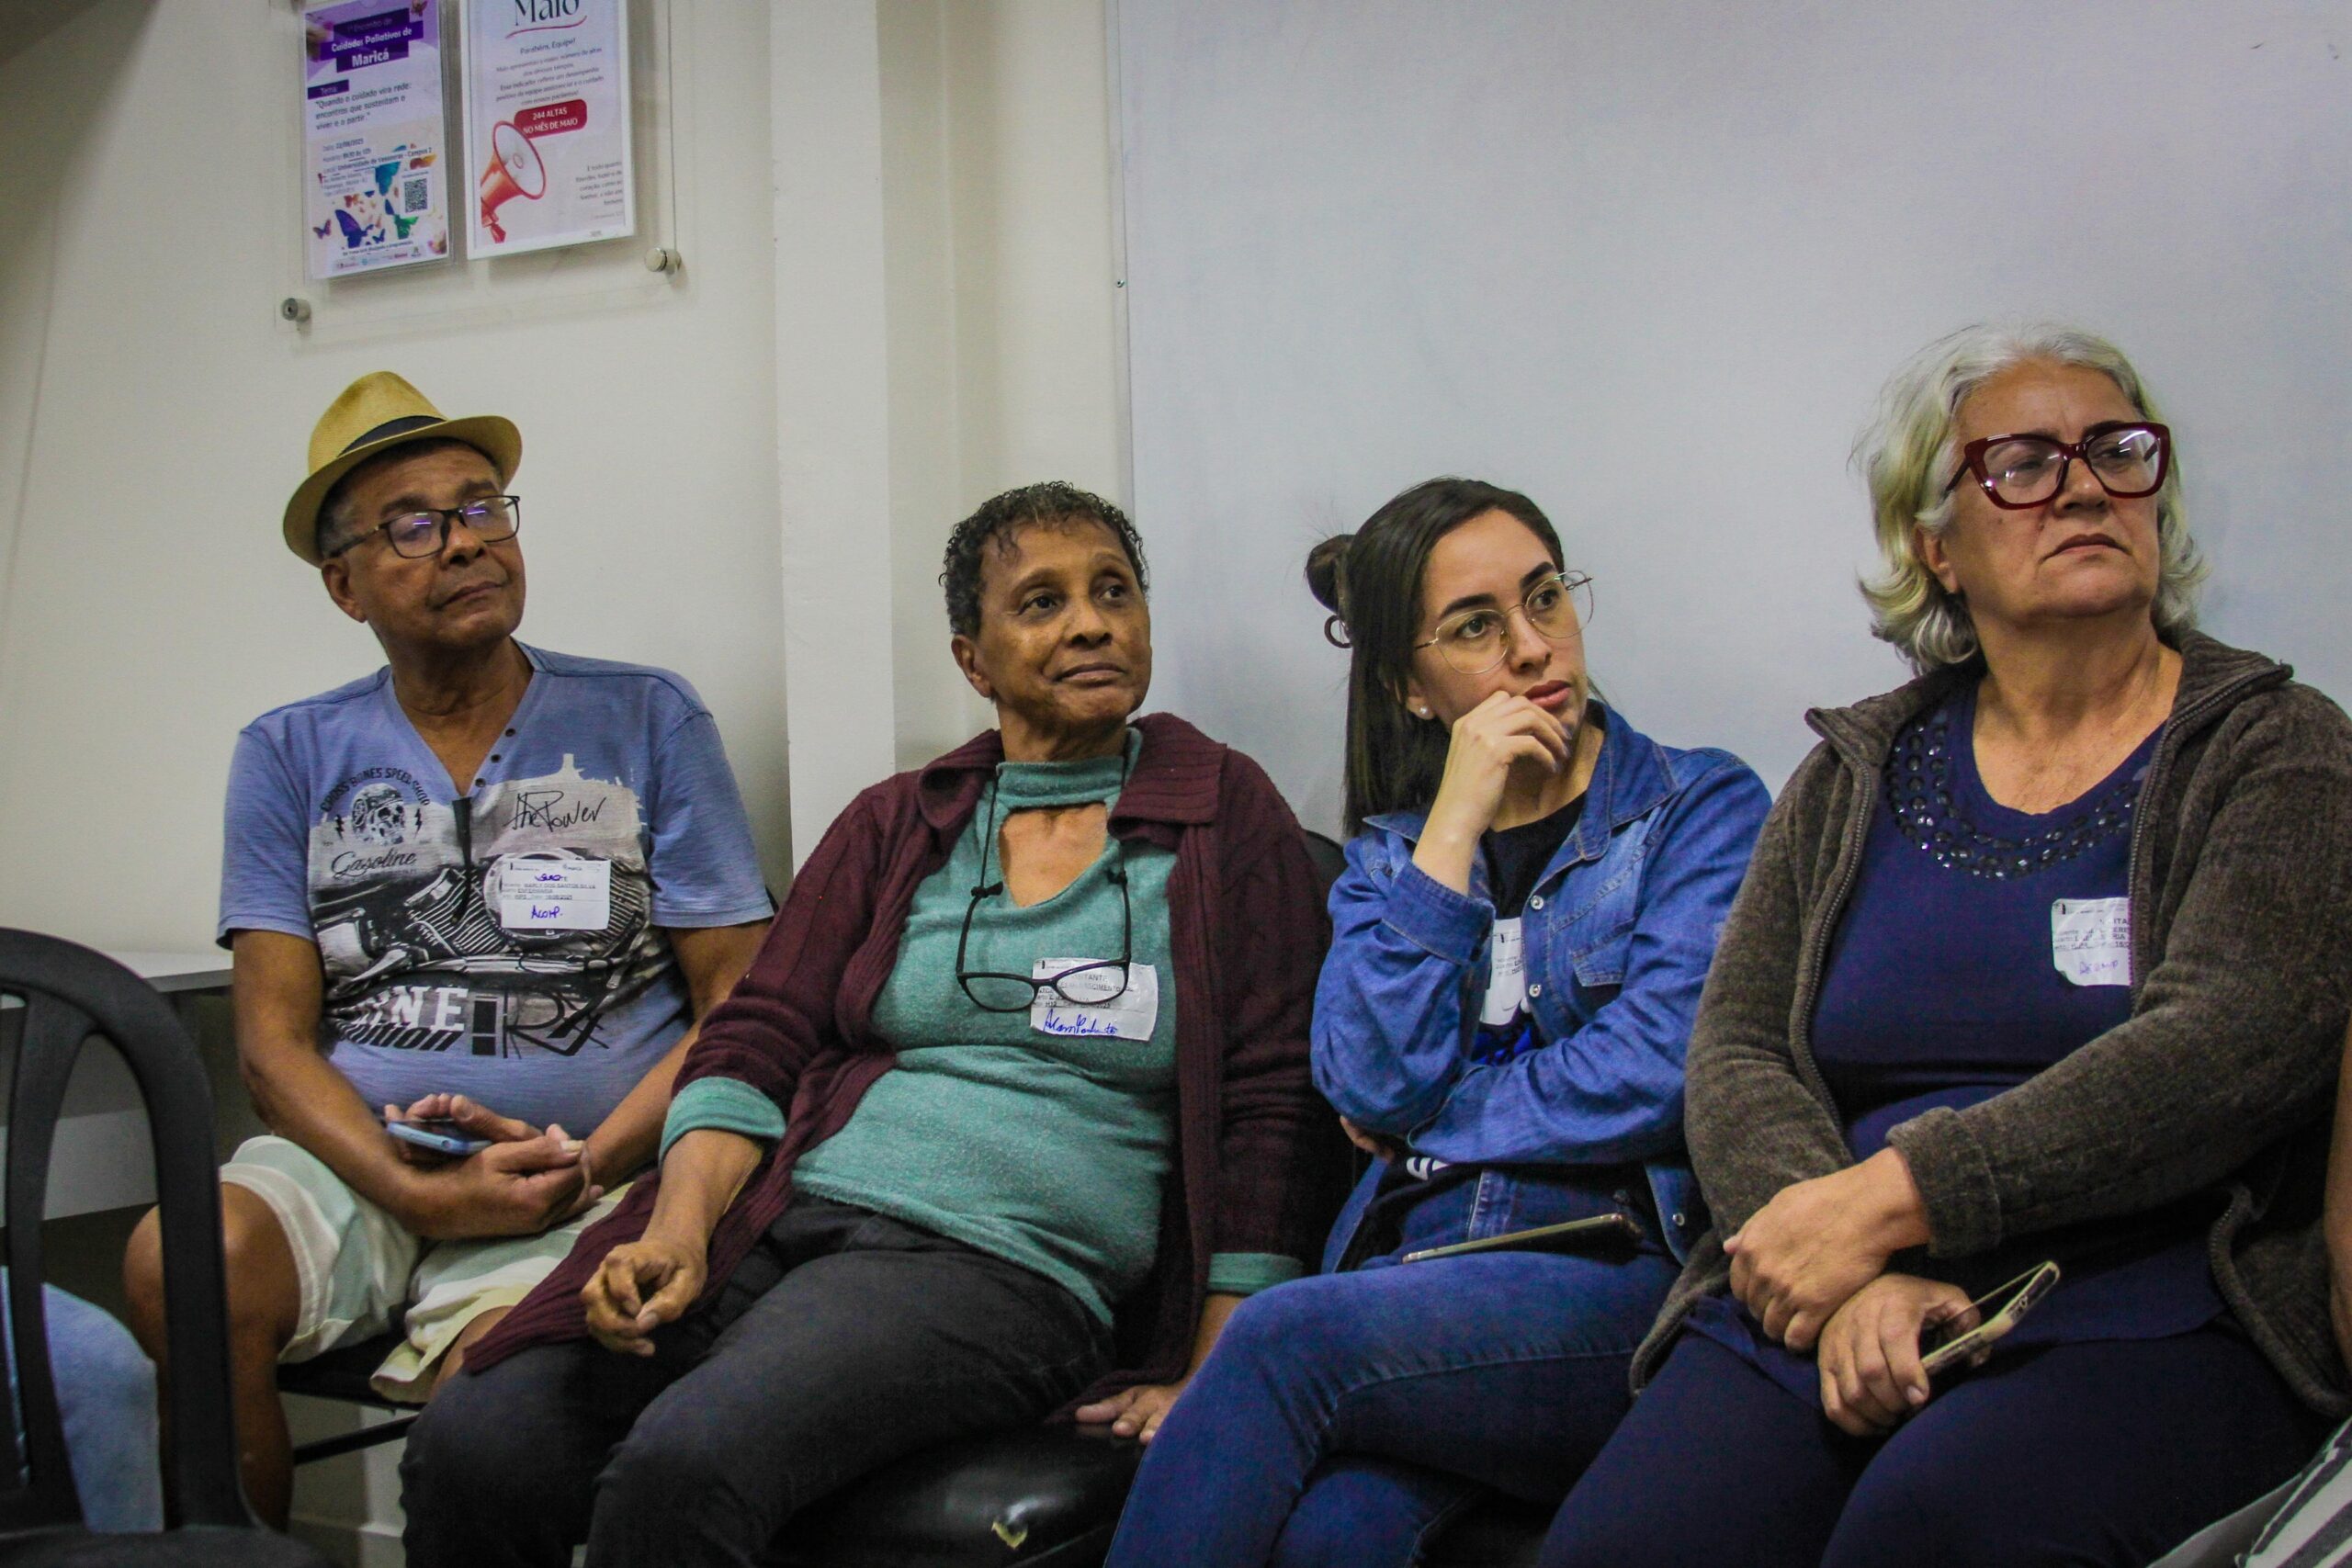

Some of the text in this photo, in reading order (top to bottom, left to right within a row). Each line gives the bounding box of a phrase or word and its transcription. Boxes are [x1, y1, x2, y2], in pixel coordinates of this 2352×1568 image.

[514, 0, 579, 26] Maio
[332, 27, 413, 52] Cuidados Paliativos de
[552, 38, 576, 49] Equipe!
[352, 48, 390, 67] Maricá
[352, 88, 378, 102] cuidado
[379, 85, 392, 95] vira
[393, 82, 412, 92] rede:
[316, 107, 347, 119] encontros
[350, 104, 362, 113] que
[533, 107, 567, 120] 244 ALTAS
[524, 126, 533, 134] NO
[534, 121, 548, 131] MÊS
[560, 118, 578, 127] MAIO
[321, 782, 350, 812] CROSS
[385, 768, 412, 784] SPEED
[331, 848, 417, 879] Gasoline
